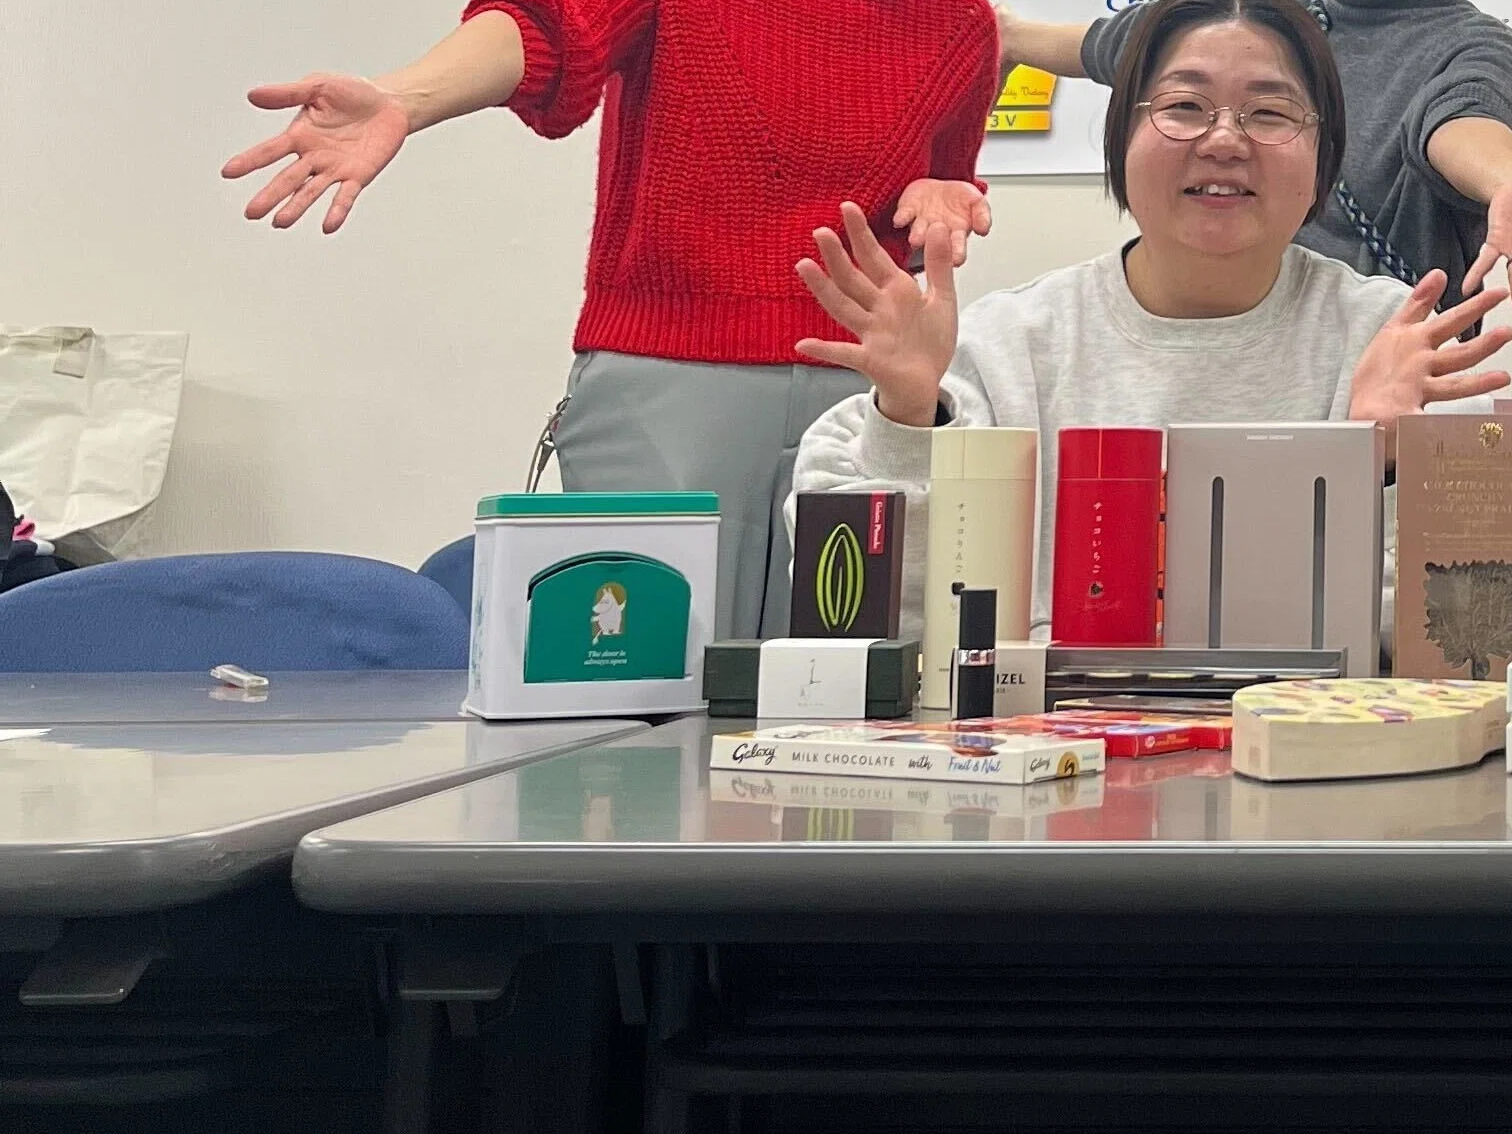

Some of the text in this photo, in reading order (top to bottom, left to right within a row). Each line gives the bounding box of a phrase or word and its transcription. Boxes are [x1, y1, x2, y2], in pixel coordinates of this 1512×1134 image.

[996, 672, 1025, 685] IZEL
[732, 743, 776, 766] Galaxy
[791, 751, 820, 764] MILK
[824, 753, 896, 768] CHOCOLATE
[908, 755, 933, 771] with
